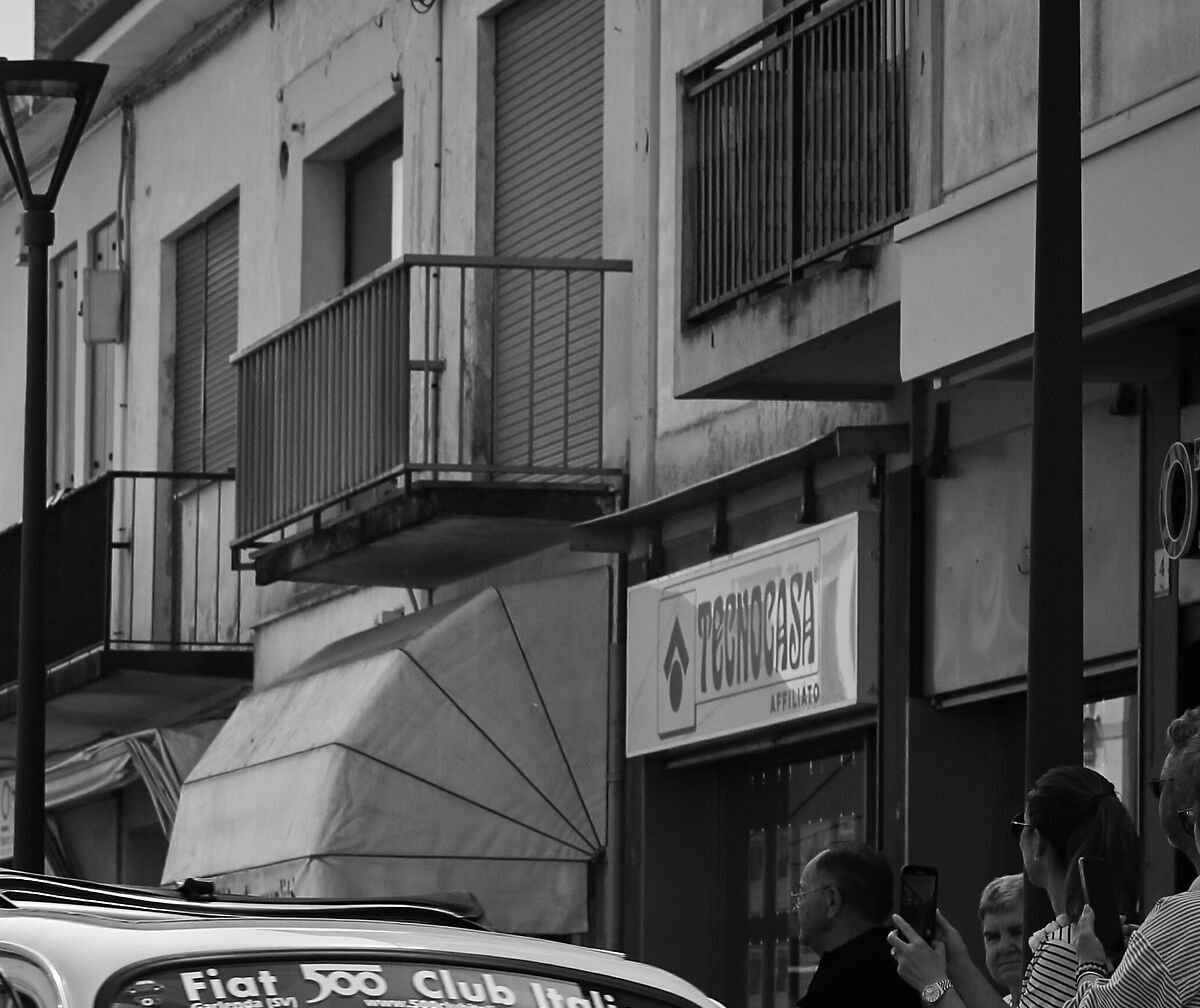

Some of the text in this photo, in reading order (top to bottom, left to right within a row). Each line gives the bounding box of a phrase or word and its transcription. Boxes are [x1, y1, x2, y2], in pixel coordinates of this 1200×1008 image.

[697, 570, 815, 693] TECNOCASA
[770, 683, 820, 714] AFFILIATO
[180, 968, 279, 1001] Fiat
[300, 964, 388, 1004] 500
[412, 969, 517, 1006] Club
